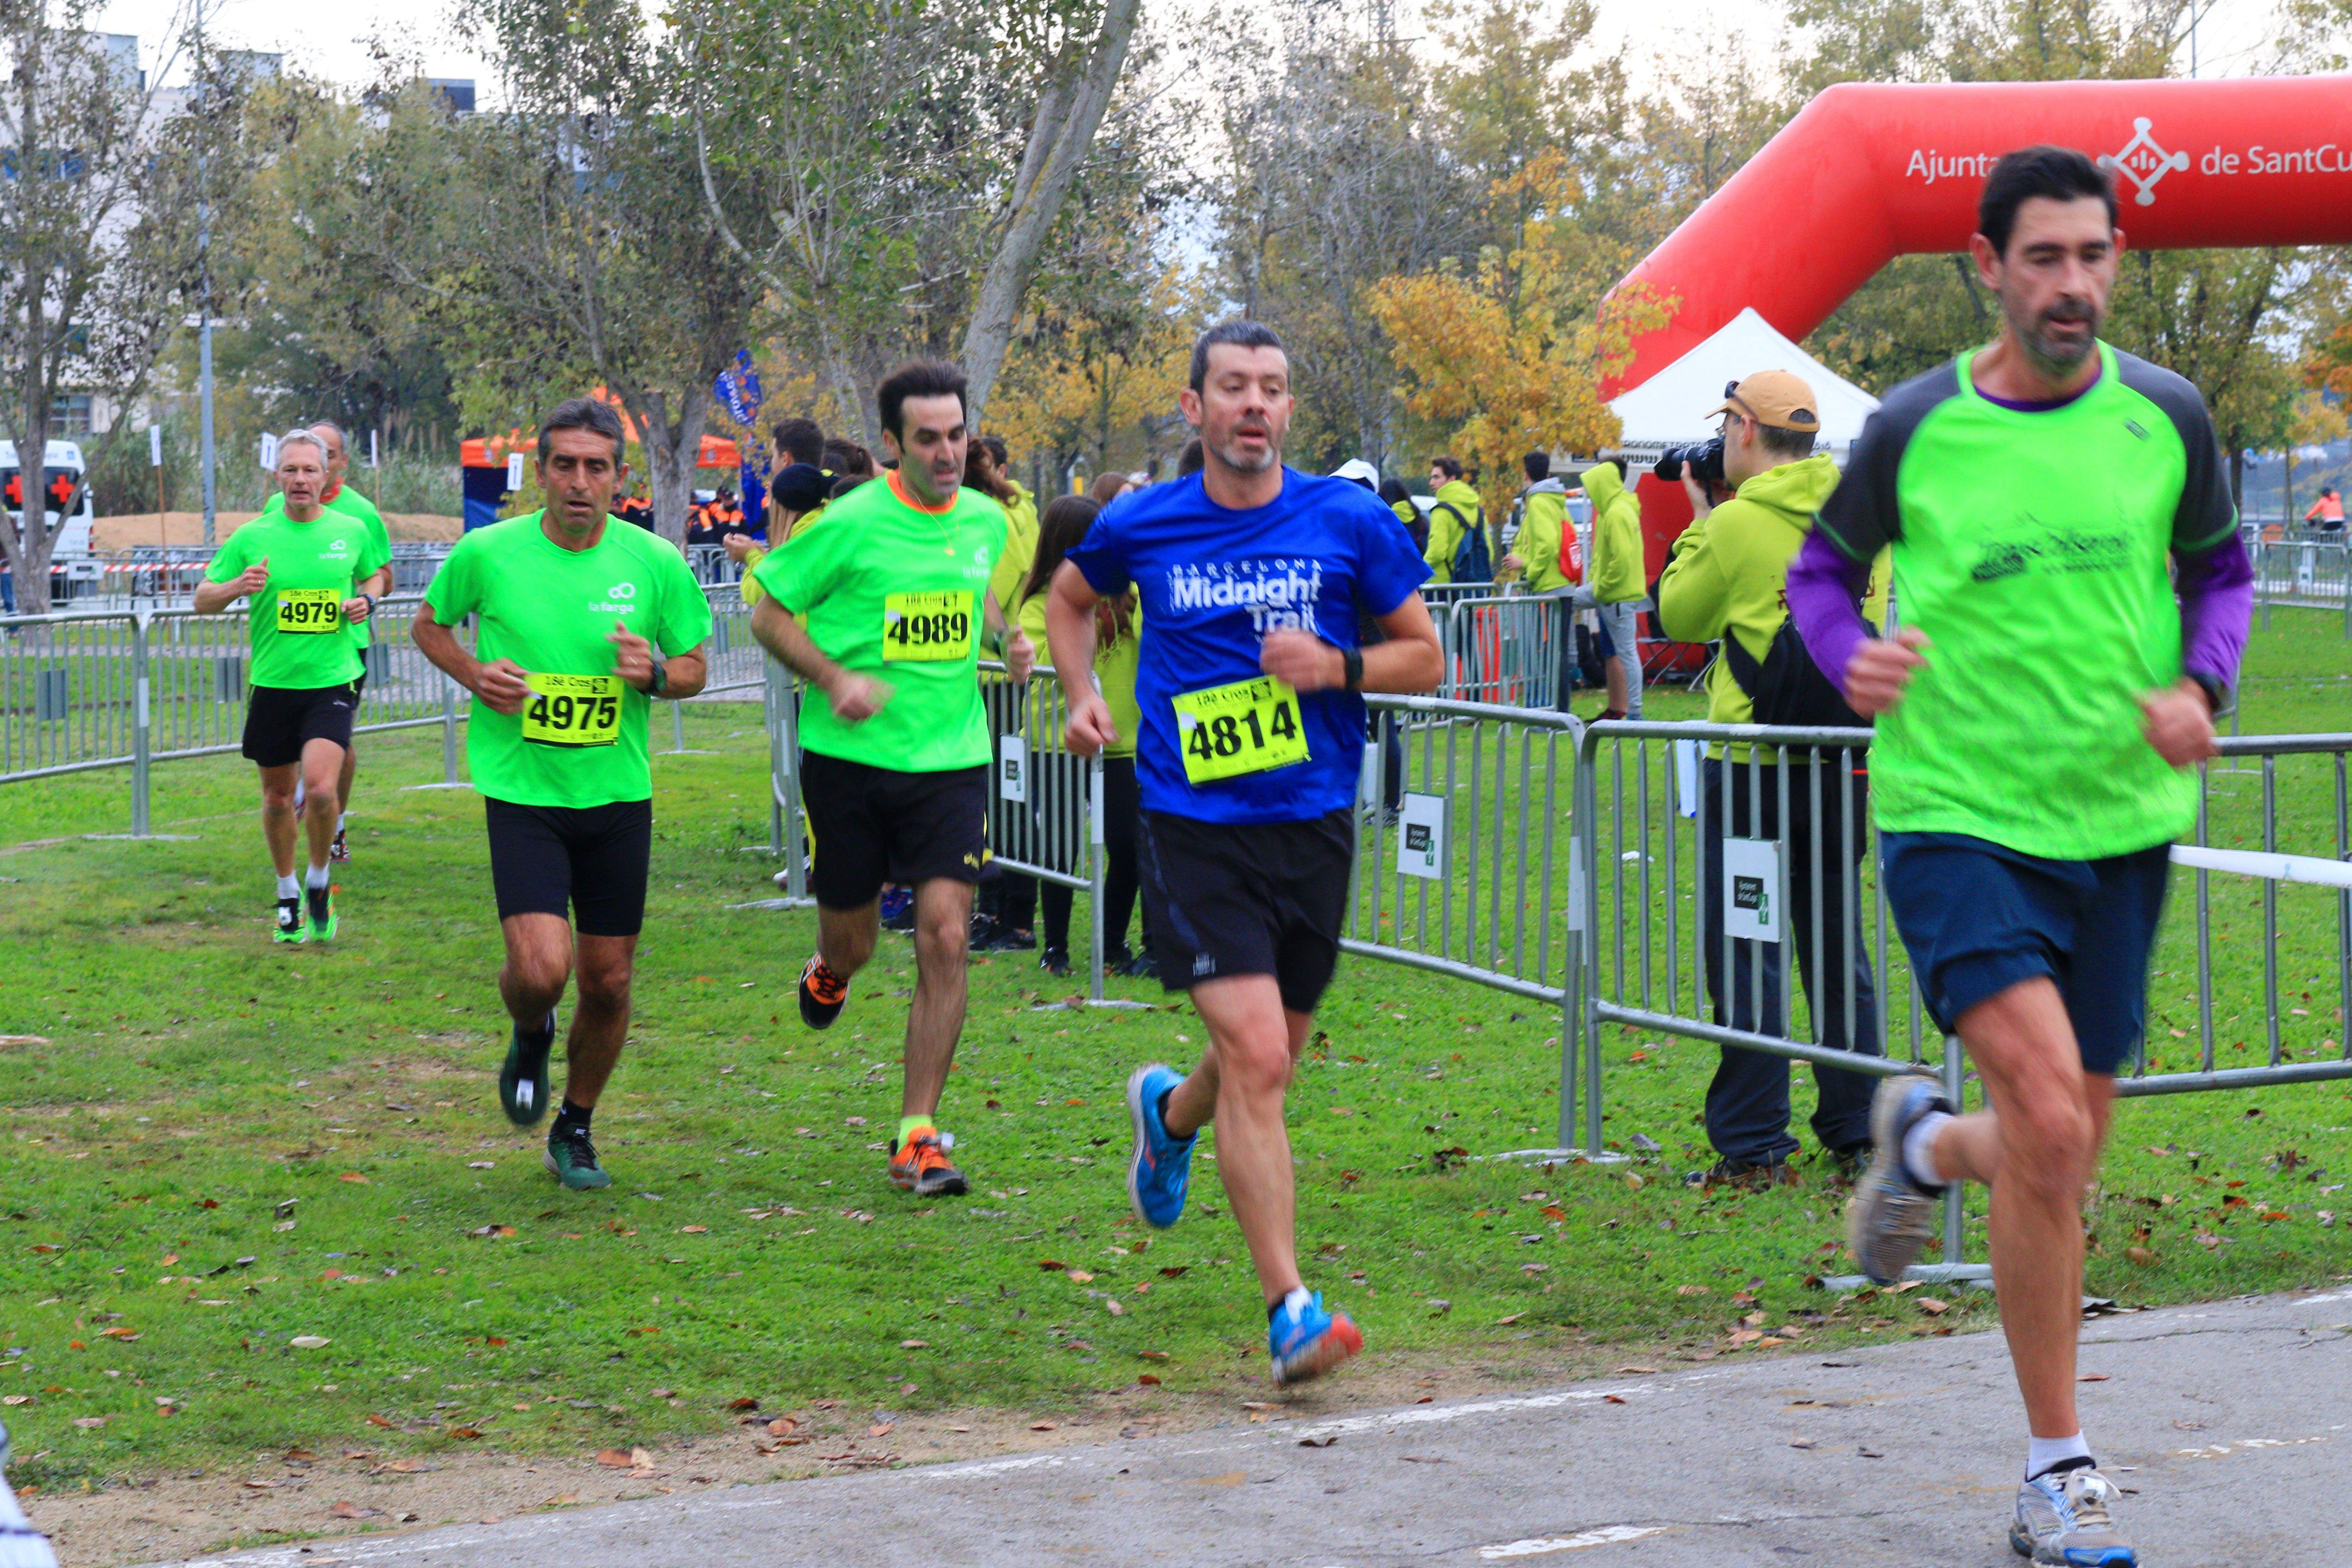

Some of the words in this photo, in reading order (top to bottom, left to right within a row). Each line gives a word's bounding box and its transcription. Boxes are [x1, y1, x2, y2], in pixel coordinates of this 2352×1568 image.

[2200, 145, 2240, 175] de
[2247, 144, 2352, 175] SantCu
[1171, 569, 1323, 609] Midnight
[281, 602, 337, 623] 4979
[588, 601, 600, 612] la
[600, 601, 634, 615] farga
[1244, 602, 1320, 635] Trail
[888, 612, 968, 645] 4989
[528, 695, 617, 730] 4975
[1188, 701, 1297, 760] 4814
